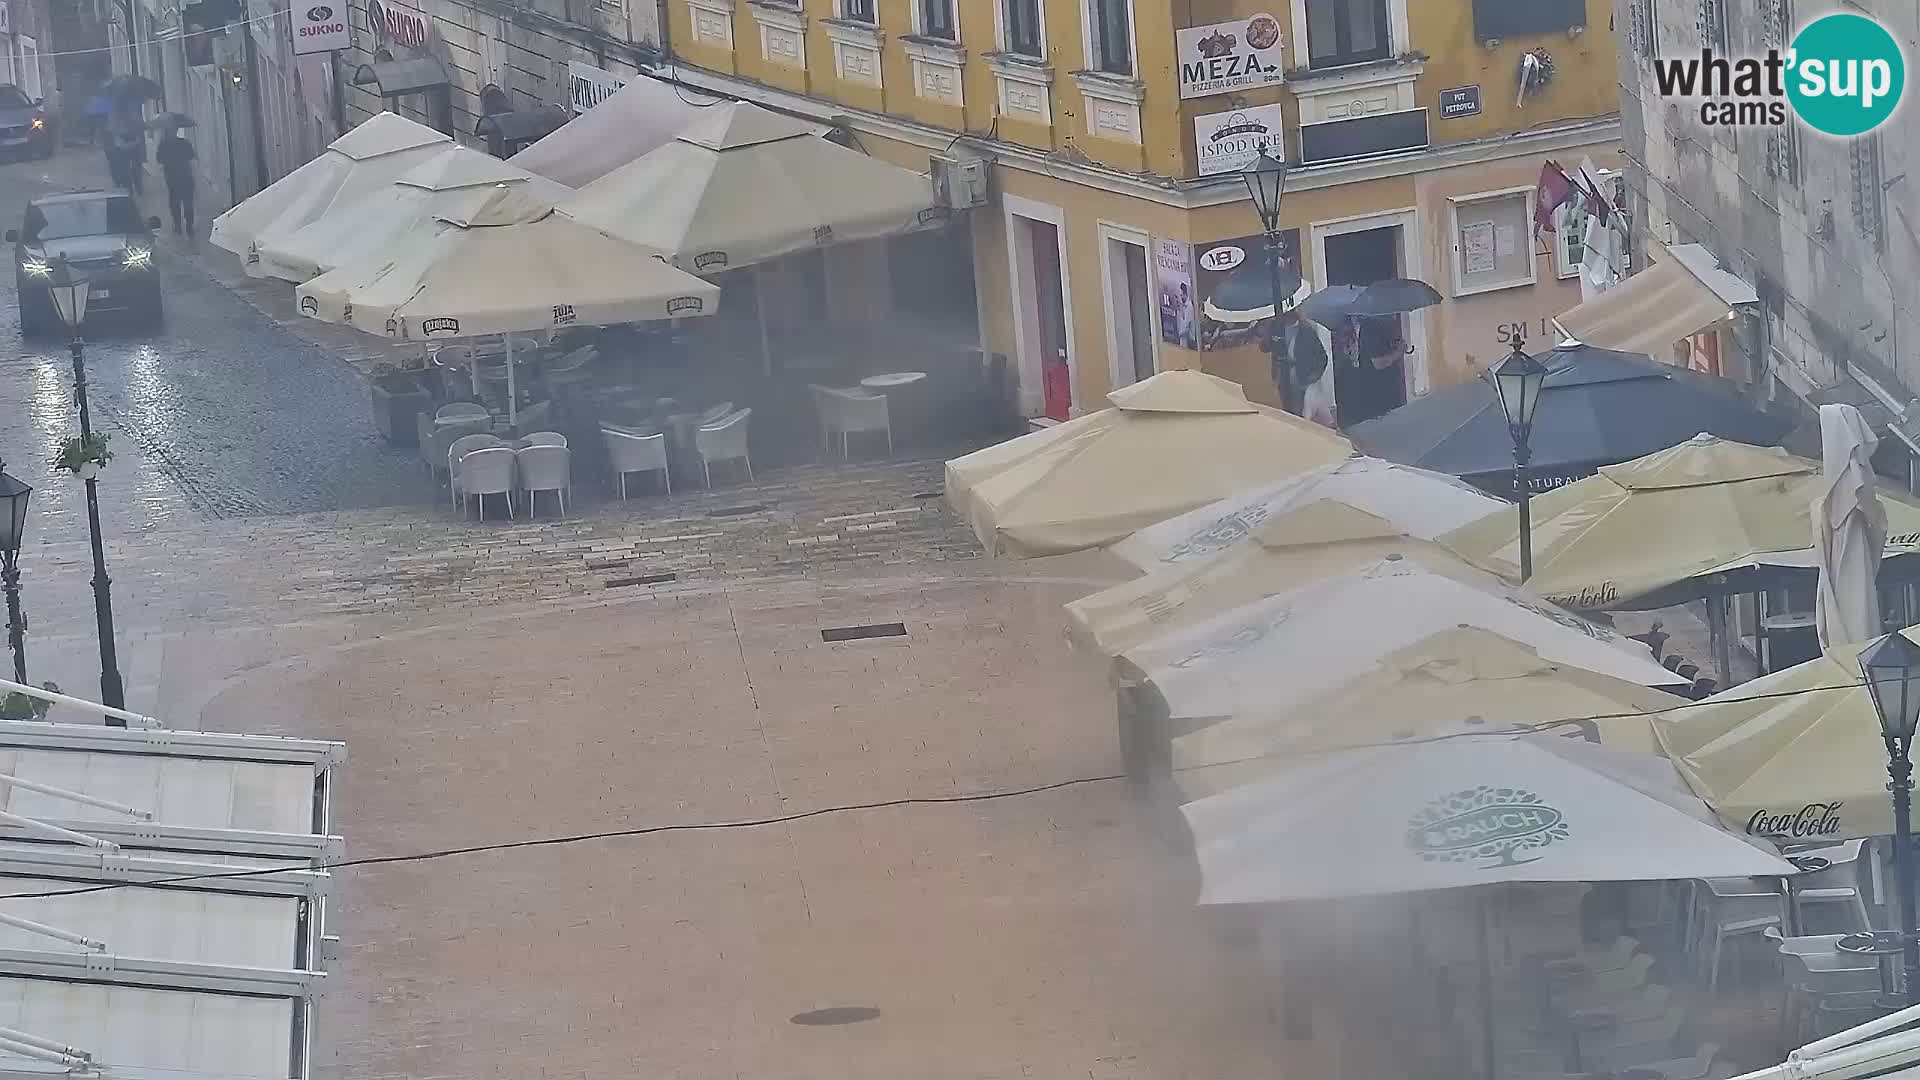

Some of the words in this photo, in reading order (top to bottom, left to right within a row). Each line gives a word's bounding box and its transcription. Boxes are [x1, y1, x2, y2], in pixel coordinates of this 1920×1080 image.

[299, 23, 343, 37] SUKNO
[1183, 54, 1261, 84] MEZA
[1192, 79, 1225, 93] PIZZERIA
[1225, 80, 1232, 88] &
[1232, 75, 1254, 86] GRILL
[1263, 75, 1280, 83] 80m
[1454, 93, 1465, 101] PUT
[1201, 139, 1247, 158] ISPOD
[1745, 801, 1844, 837] Coca-Cola
